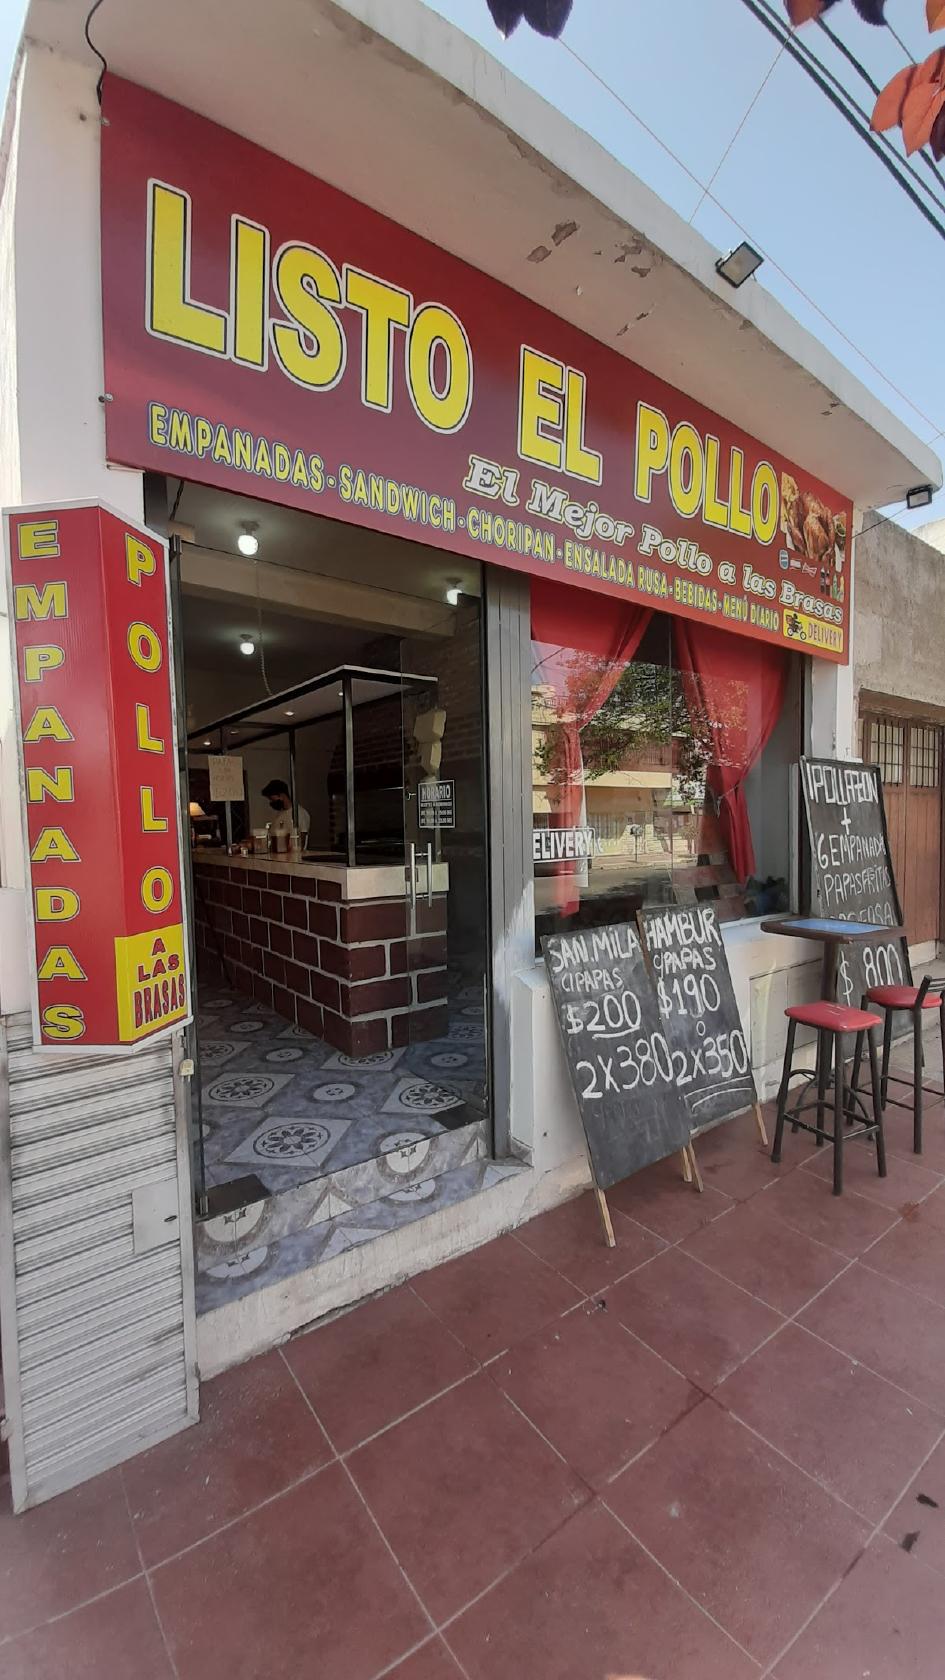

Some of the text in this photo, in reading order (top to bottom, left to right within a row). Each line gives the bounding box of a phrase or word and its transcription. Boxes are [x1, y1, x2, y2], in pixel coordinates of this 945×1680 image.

[145, 177, 779, 546] LISTO EL POLLO
[148, 402, 780, 632] EMPANADAS SANDWICH CHORIPAN ENSALADA RUSA BEBIDAS MENÚ DIARIO
[463, 455, 844, 624] El Mejor Pollo a las Brasas
[807, 622, 842, 648] DELIVERY
[126, 533, 174, 914] POLLO
[15, 520, 87, 1040] EMPANADAS
[421, 784, 450, 801] HORARIO
[533, 831, 592, 859] ELIVERY
[151, 937, 166, 956] A
[643, 908, 722, 951] HAMBUR
[138, 954, 180, 982] LAS
[134, 974, 185, 1028] BRASAS
[567, 990, 641, 1034] $200
